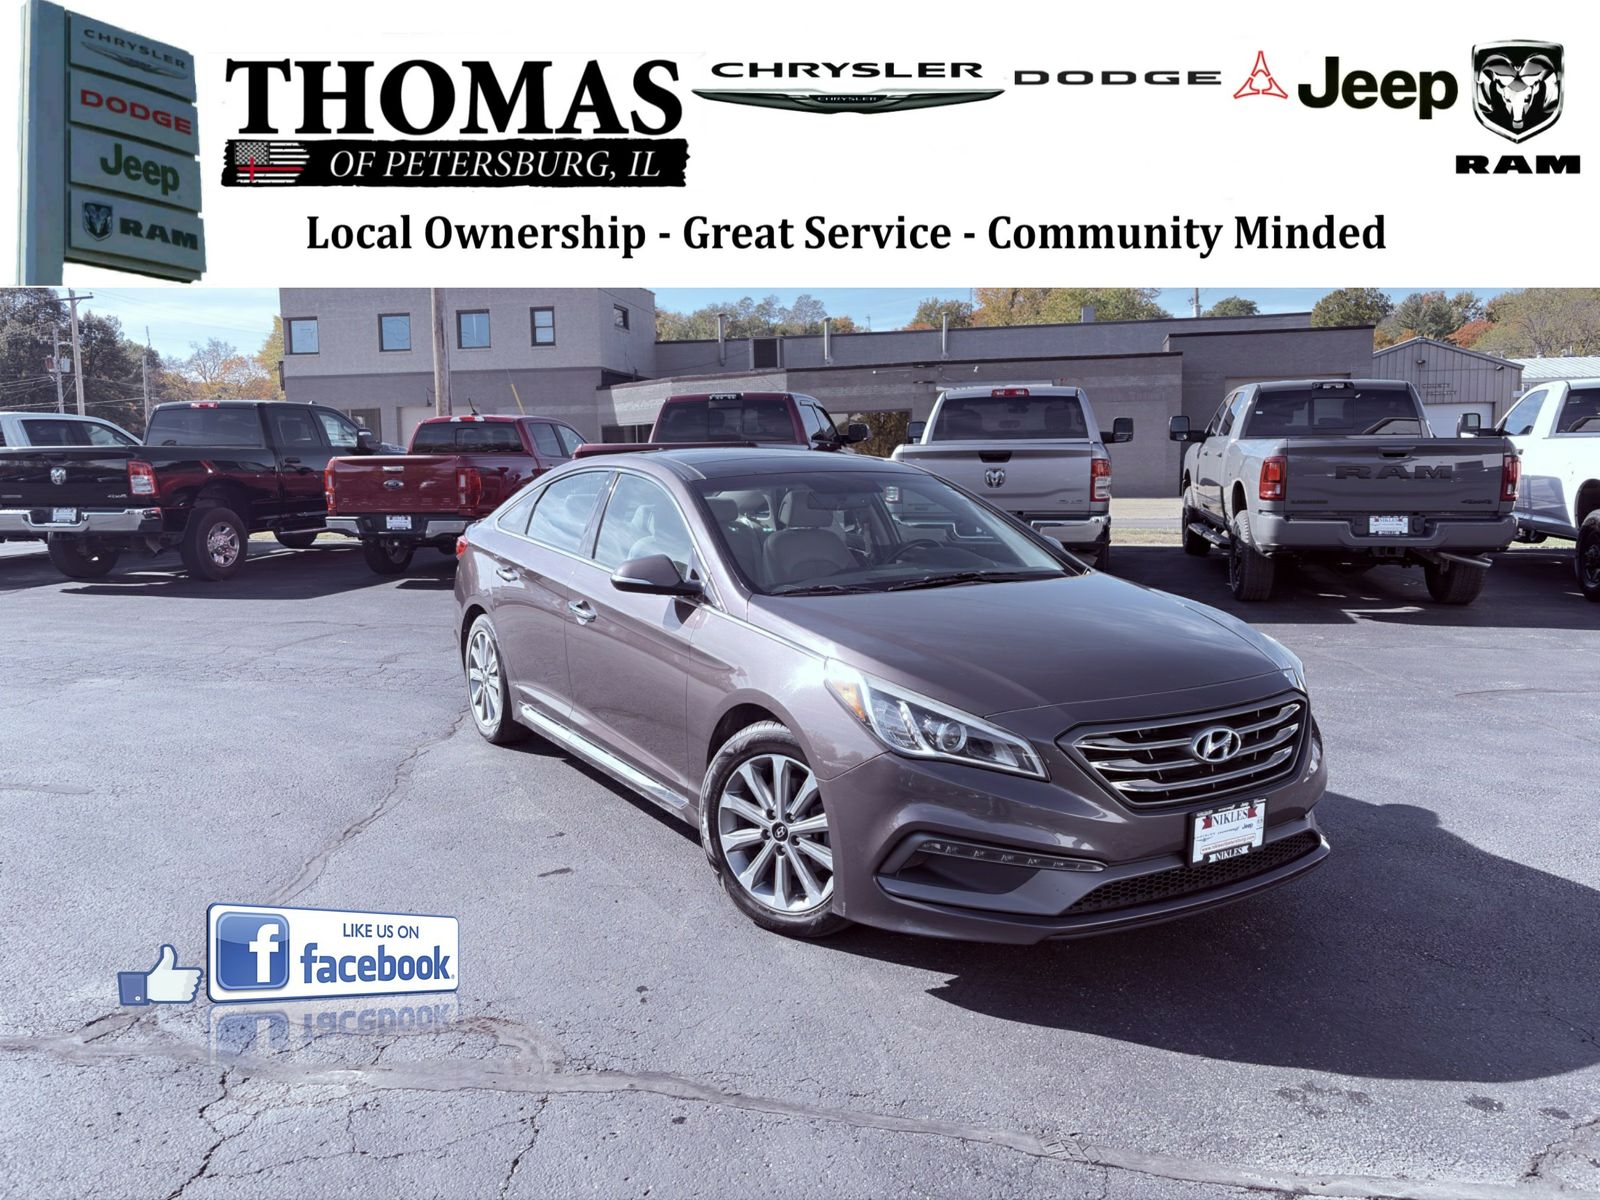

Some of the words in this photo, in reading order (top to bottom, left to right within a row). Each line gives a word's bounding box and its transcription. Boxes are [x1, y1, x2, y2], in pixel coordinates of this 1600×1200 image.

[1335, 465, 1453, 480] RAM
[1213, 809, 1248, 825] NIKLES
[1216, 846, 1242, 861] NIKLES
